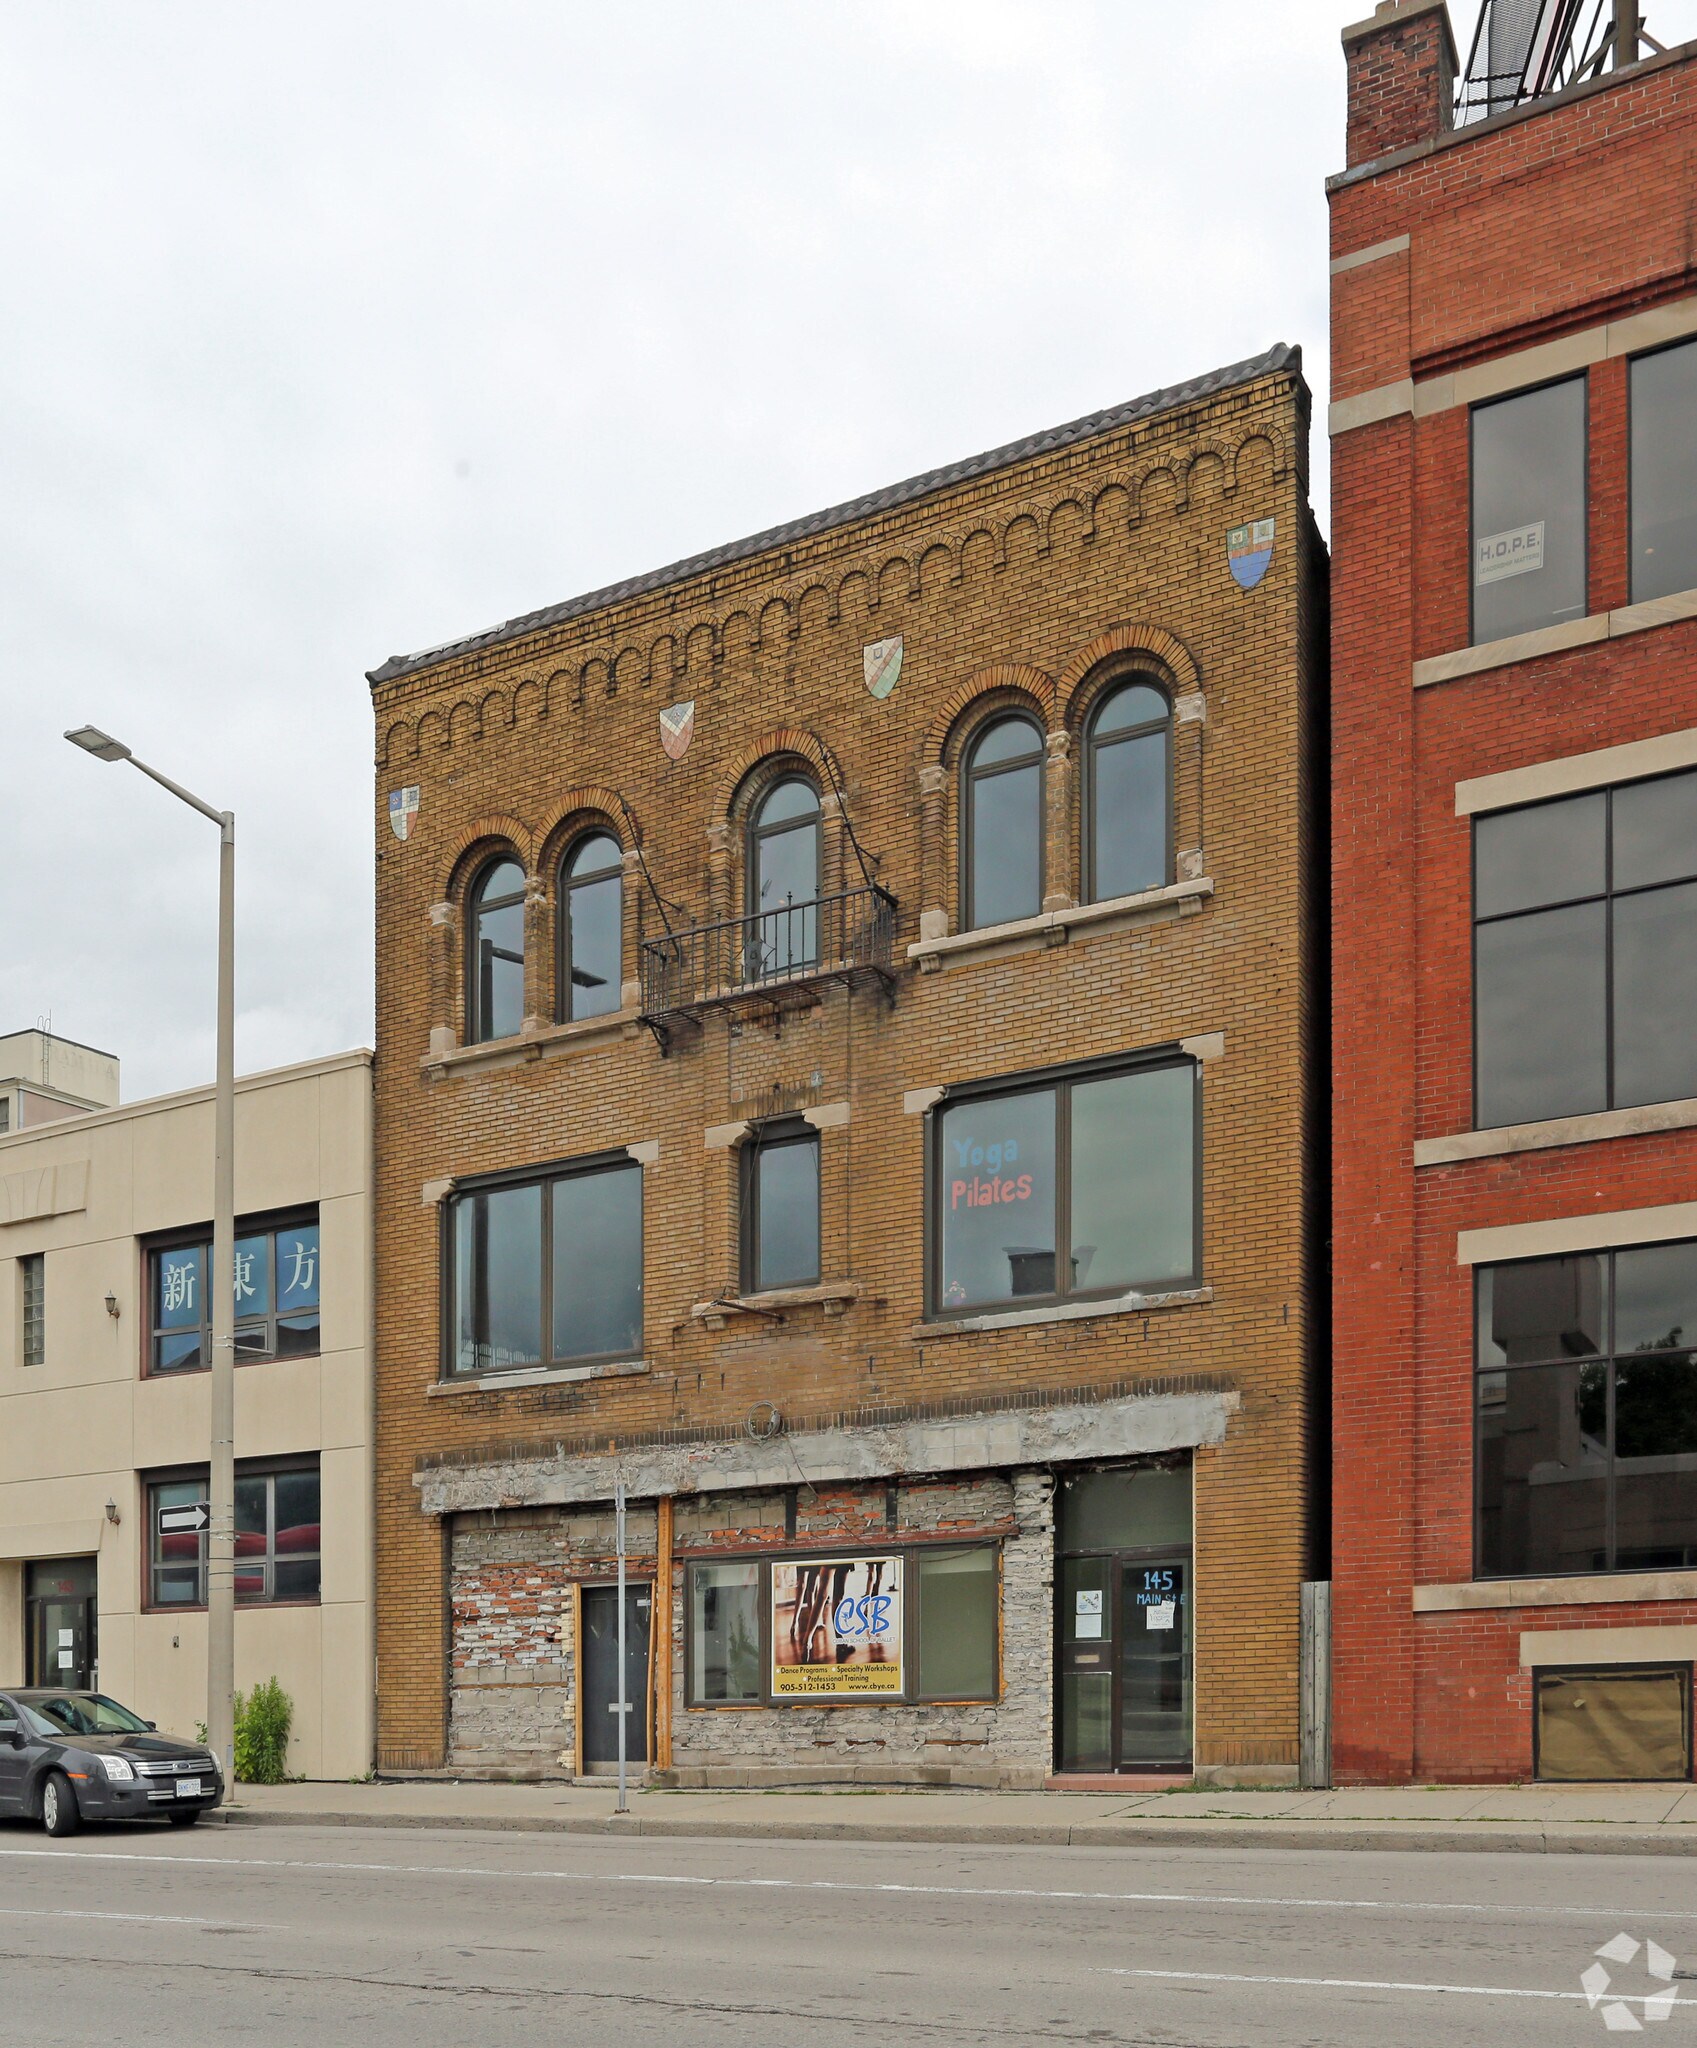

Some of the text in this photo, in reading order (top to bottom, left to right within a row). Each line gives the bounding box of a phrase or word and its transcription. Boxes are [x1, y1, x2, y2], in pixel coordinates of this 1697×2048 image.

[1480, 532, 1540, 562] H.O.P.E.
[953, 1136, 1018, 1175] Yoga
[952, 1174, 1033, 1210] Pilates
[1143, 1570, 1173, 1590] 145
[1136, 1593, 1162, 1605] MAIN
[835, 1595, 892, 1636] CSB
[800, 1667, 828, 1675] Programs
[837, 1665, 864, 1674] Specialty
[807, 1674, 869, 1682] Professional Training
[780, 1682, 836, 1691] 905-512-1453
[848, 1682, 895, 1690] www.cbye.ca
